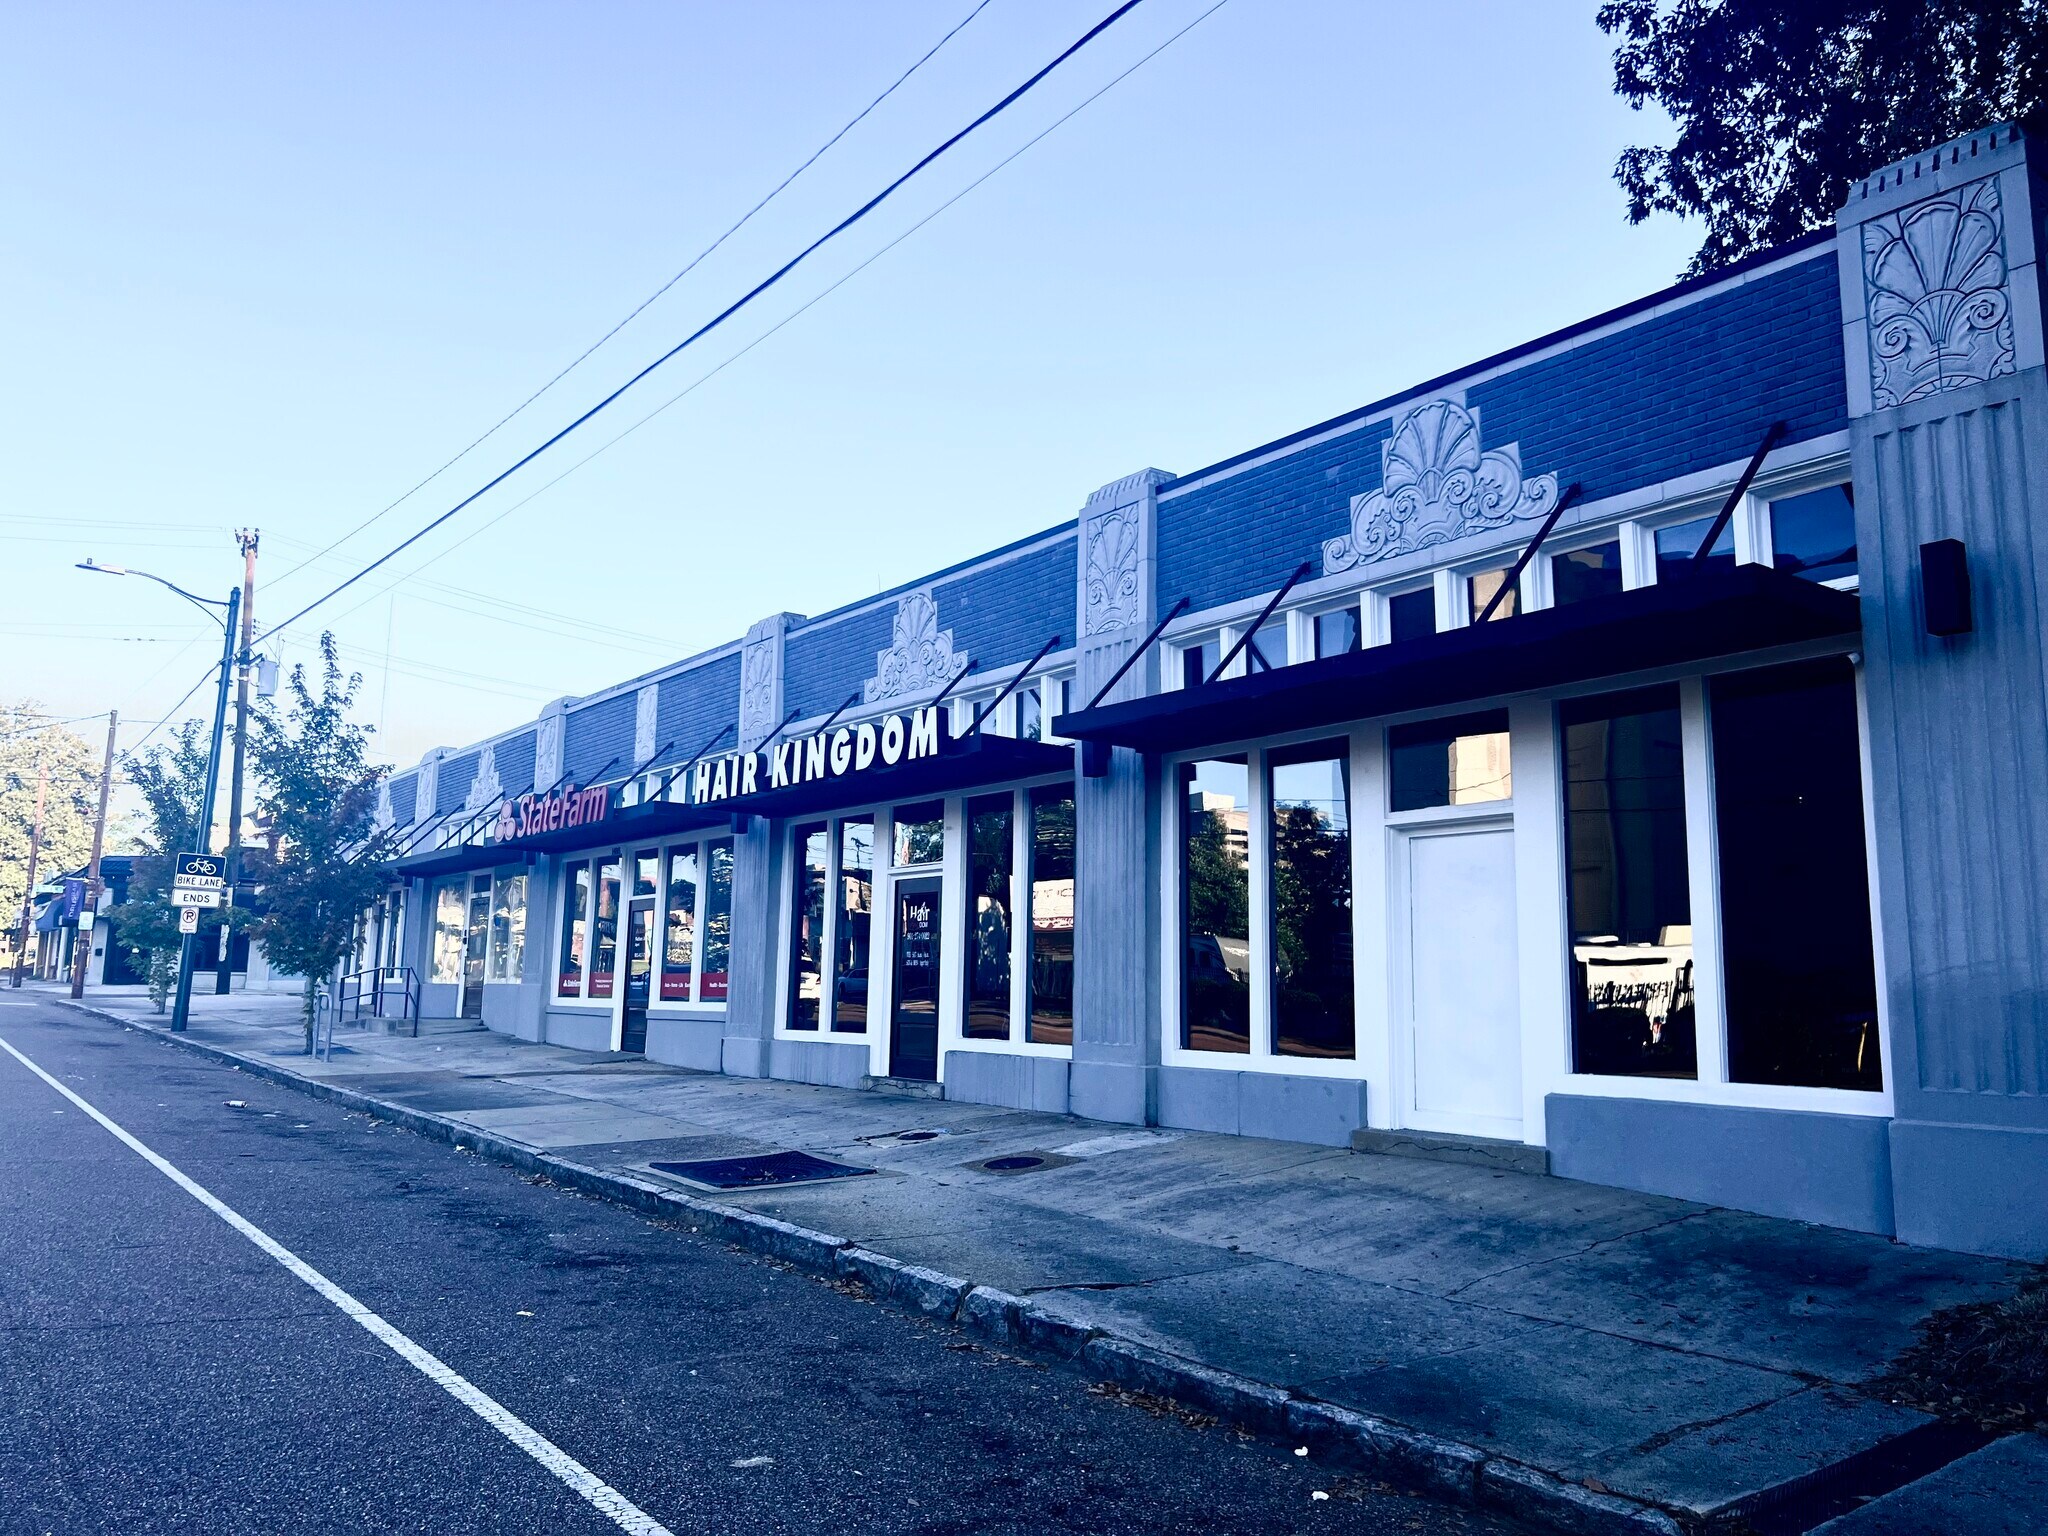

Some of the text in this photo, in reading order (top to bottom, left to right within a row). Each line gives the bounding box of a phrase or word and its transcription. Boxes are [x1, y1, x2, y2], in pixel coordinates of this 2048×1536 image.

[694, 706, 938, 805] HAIR KINGDOM
[177, 876, 221, 887] BIKE LANE
[183, 893, 210, 903] ENDS
